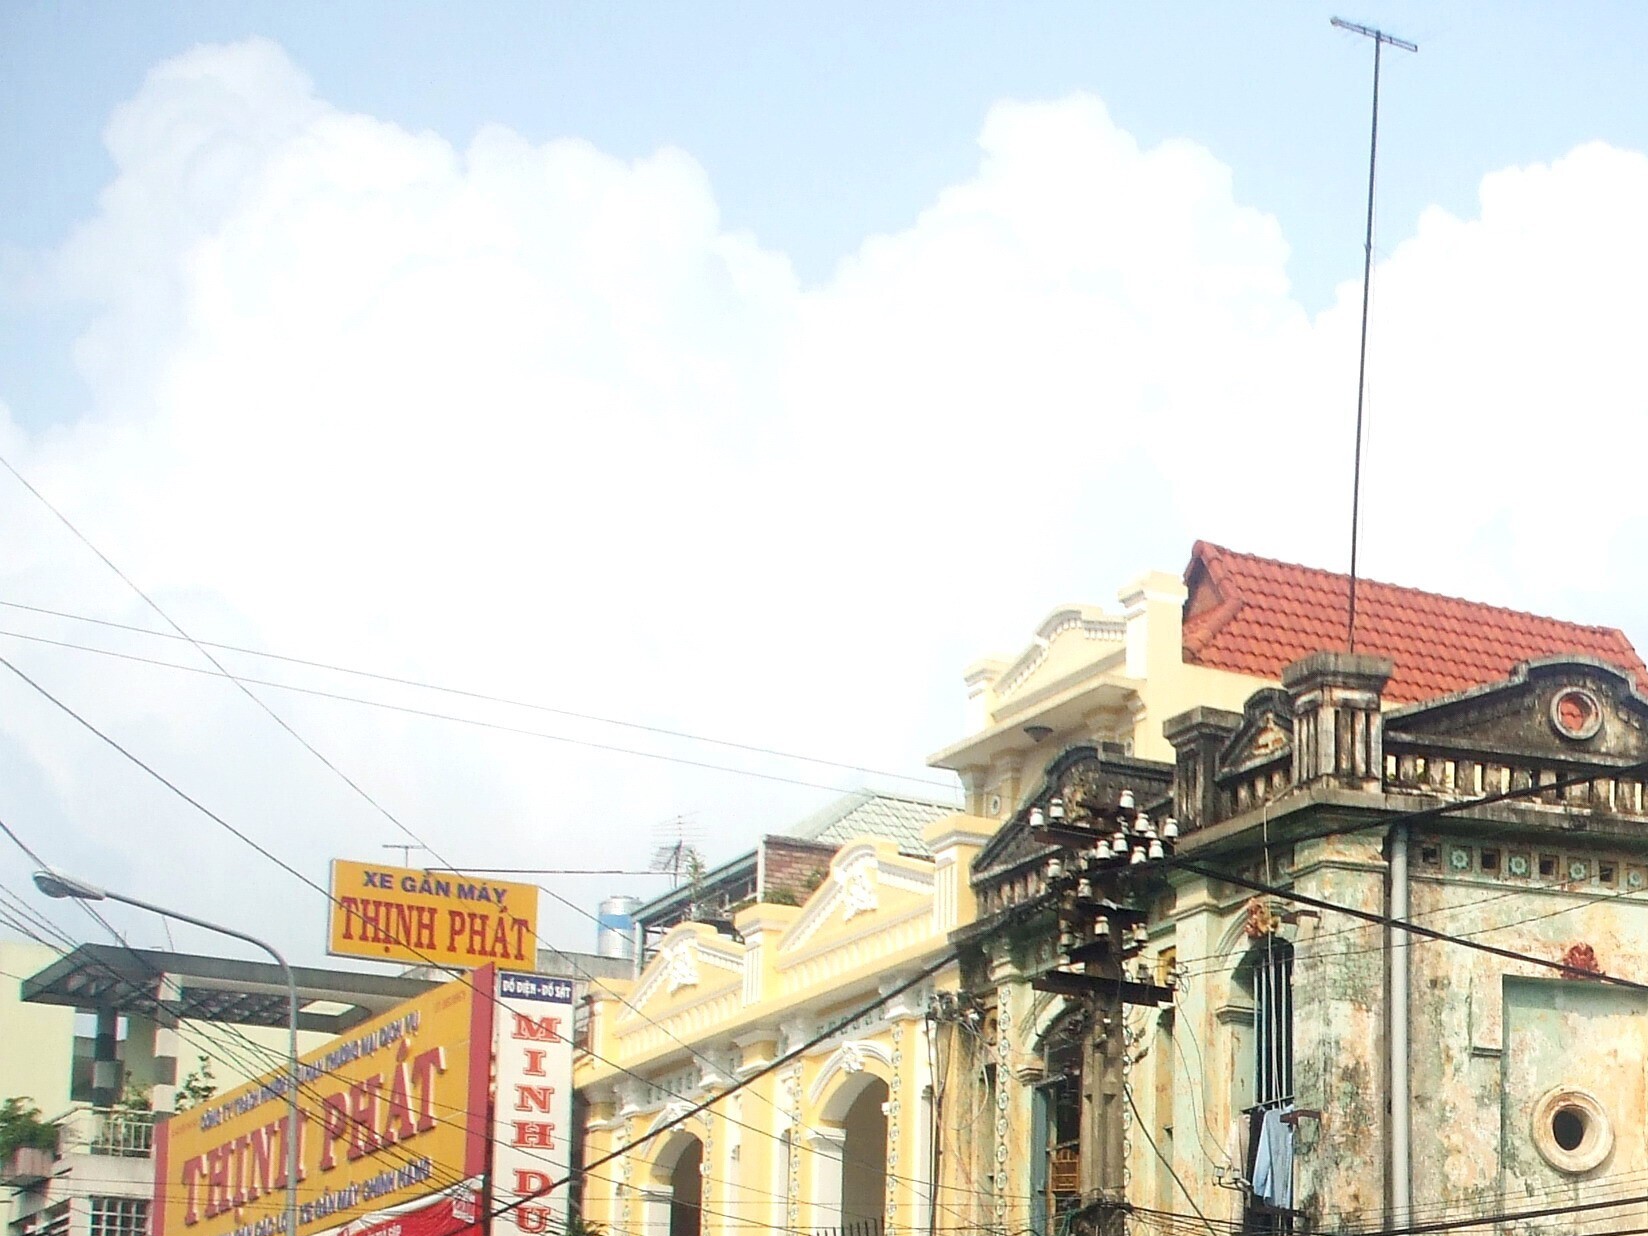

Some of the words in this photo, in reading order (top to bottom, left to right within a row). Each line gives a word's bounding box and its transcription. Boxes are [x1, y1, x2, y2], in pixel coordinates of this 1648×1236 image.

[339, 896, 438, 953] THỊNH
[447, 905, 530, 961] PHÁT
[363, 870, 393, 890] XE
[457, 882, 508, 904] MÁY
[511, 1012, 561, 1150] MINH
[181, 1107, 310, 1228] THỊNH
[320, 1036, 447, 1172] PHÁT
